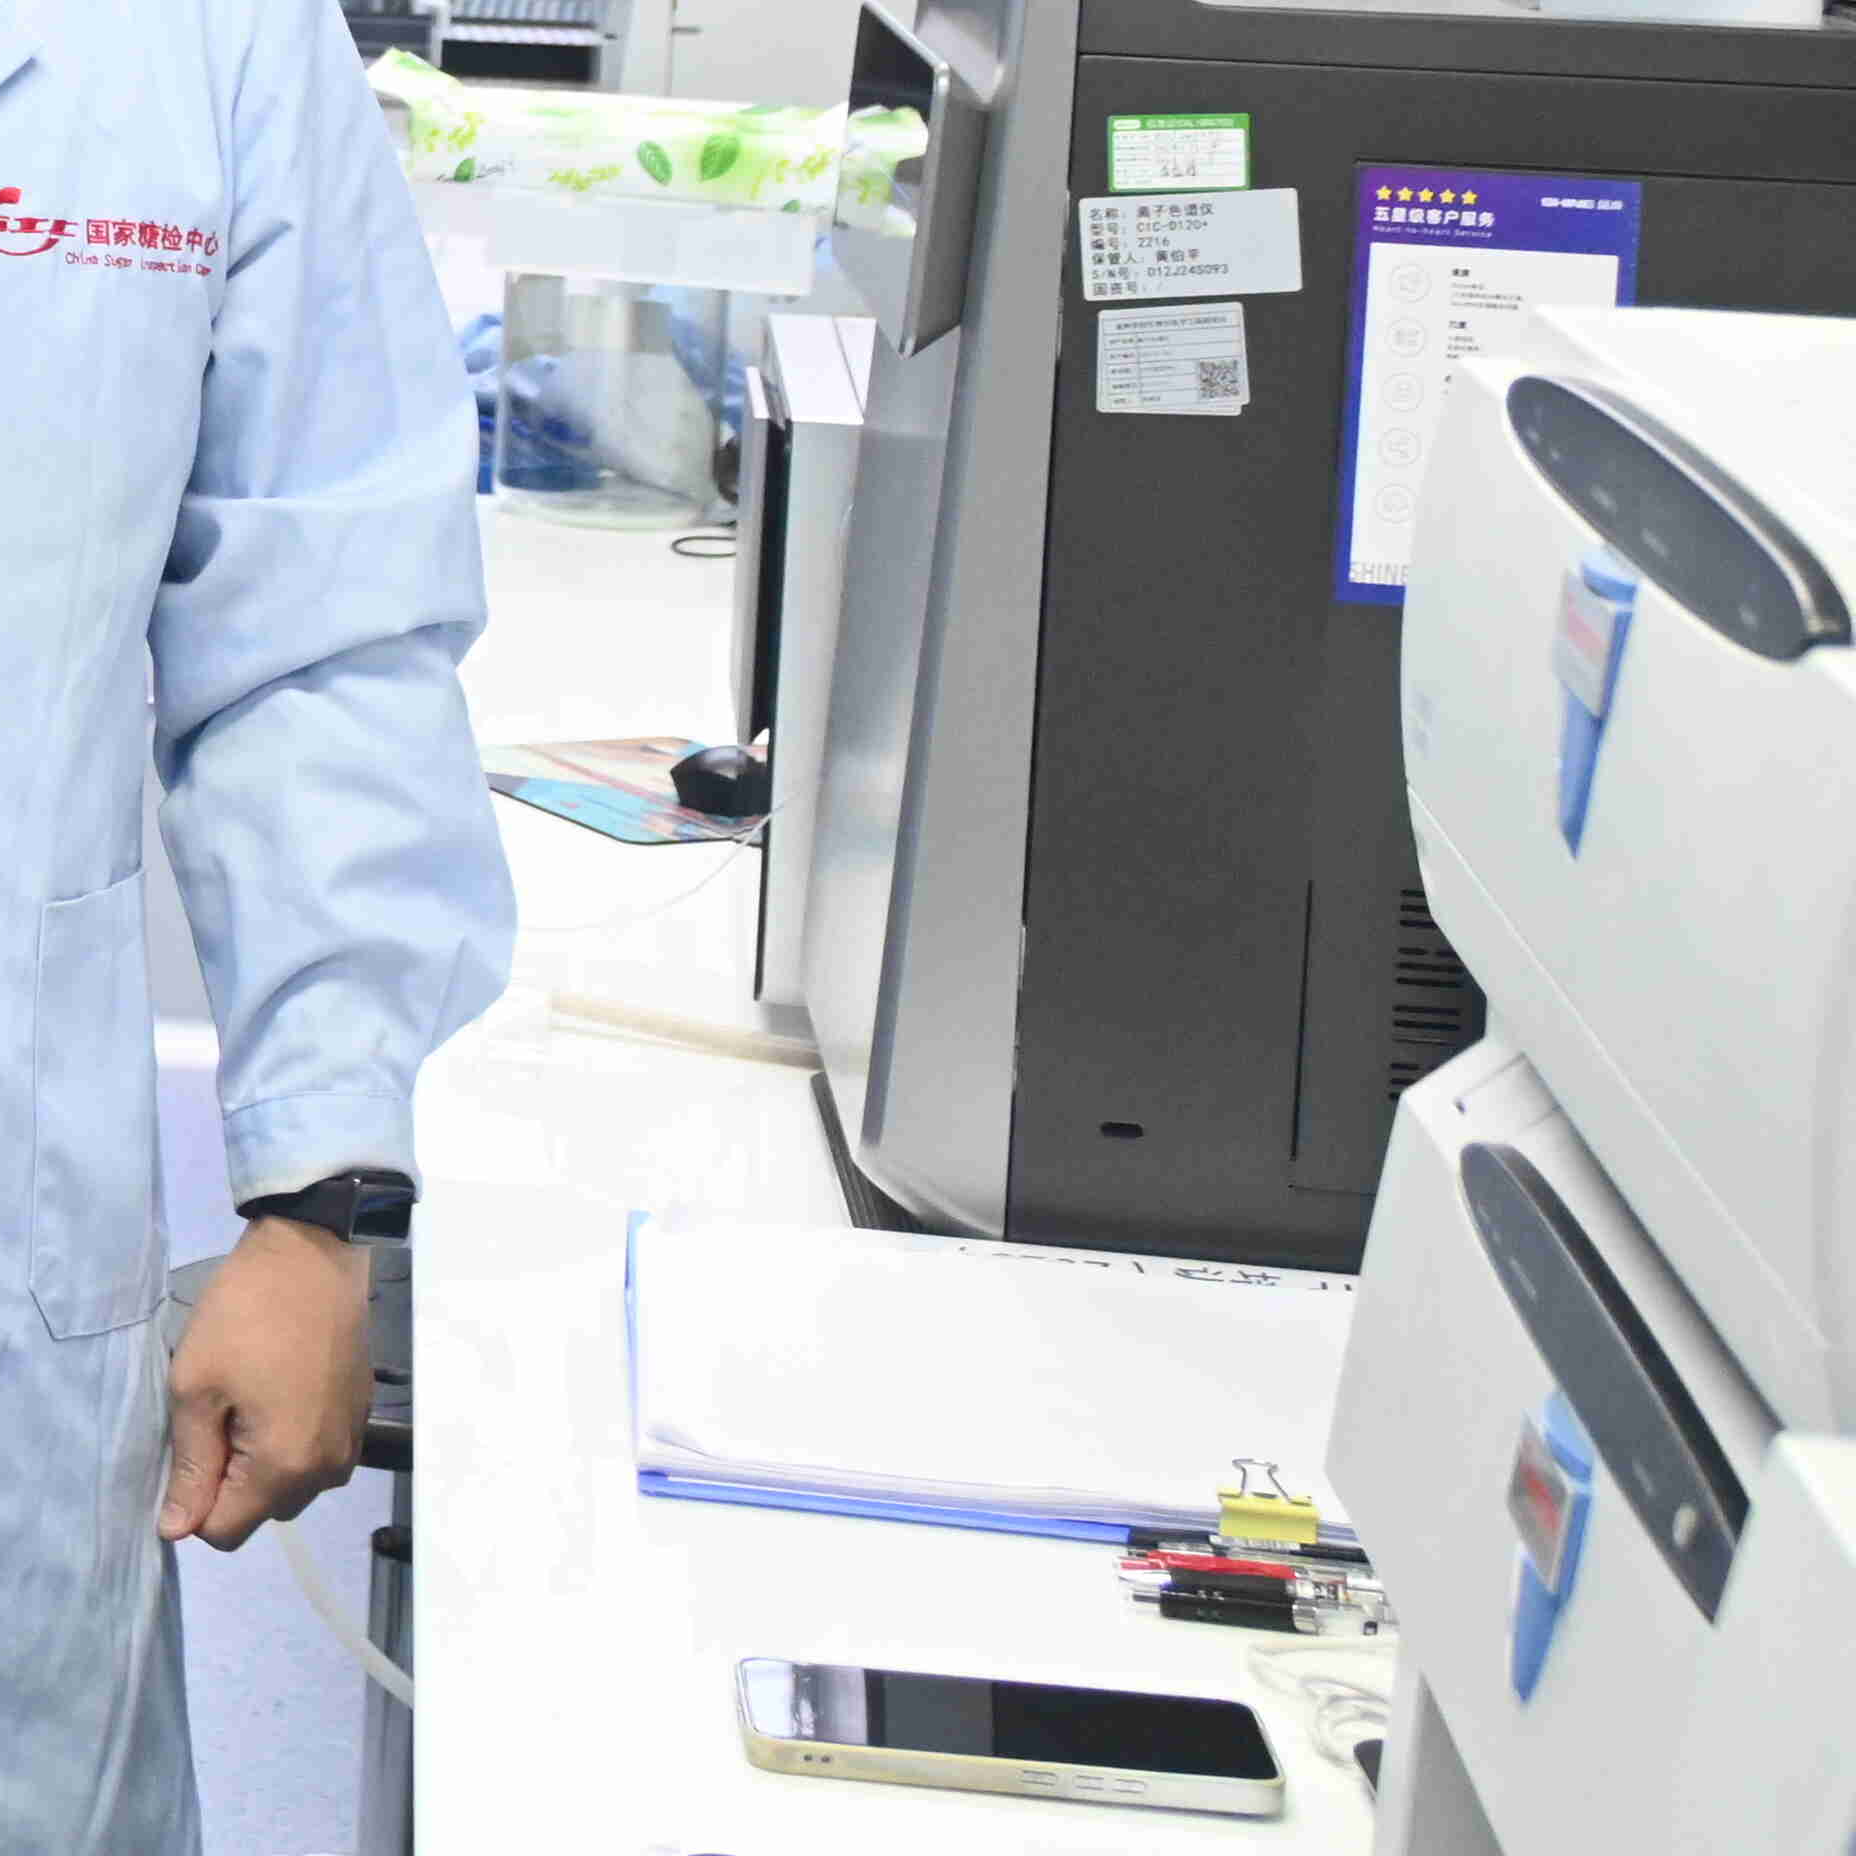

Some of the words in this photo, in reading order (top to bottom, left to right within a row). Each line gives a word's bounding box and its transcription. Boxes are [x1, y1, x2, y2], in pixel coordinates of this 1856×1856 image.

[1373, 206, 1495, 228] 五星级客户服务
[86, 218, 219, 256] 国家糖检中心
[65, 251, 98, 265] China
